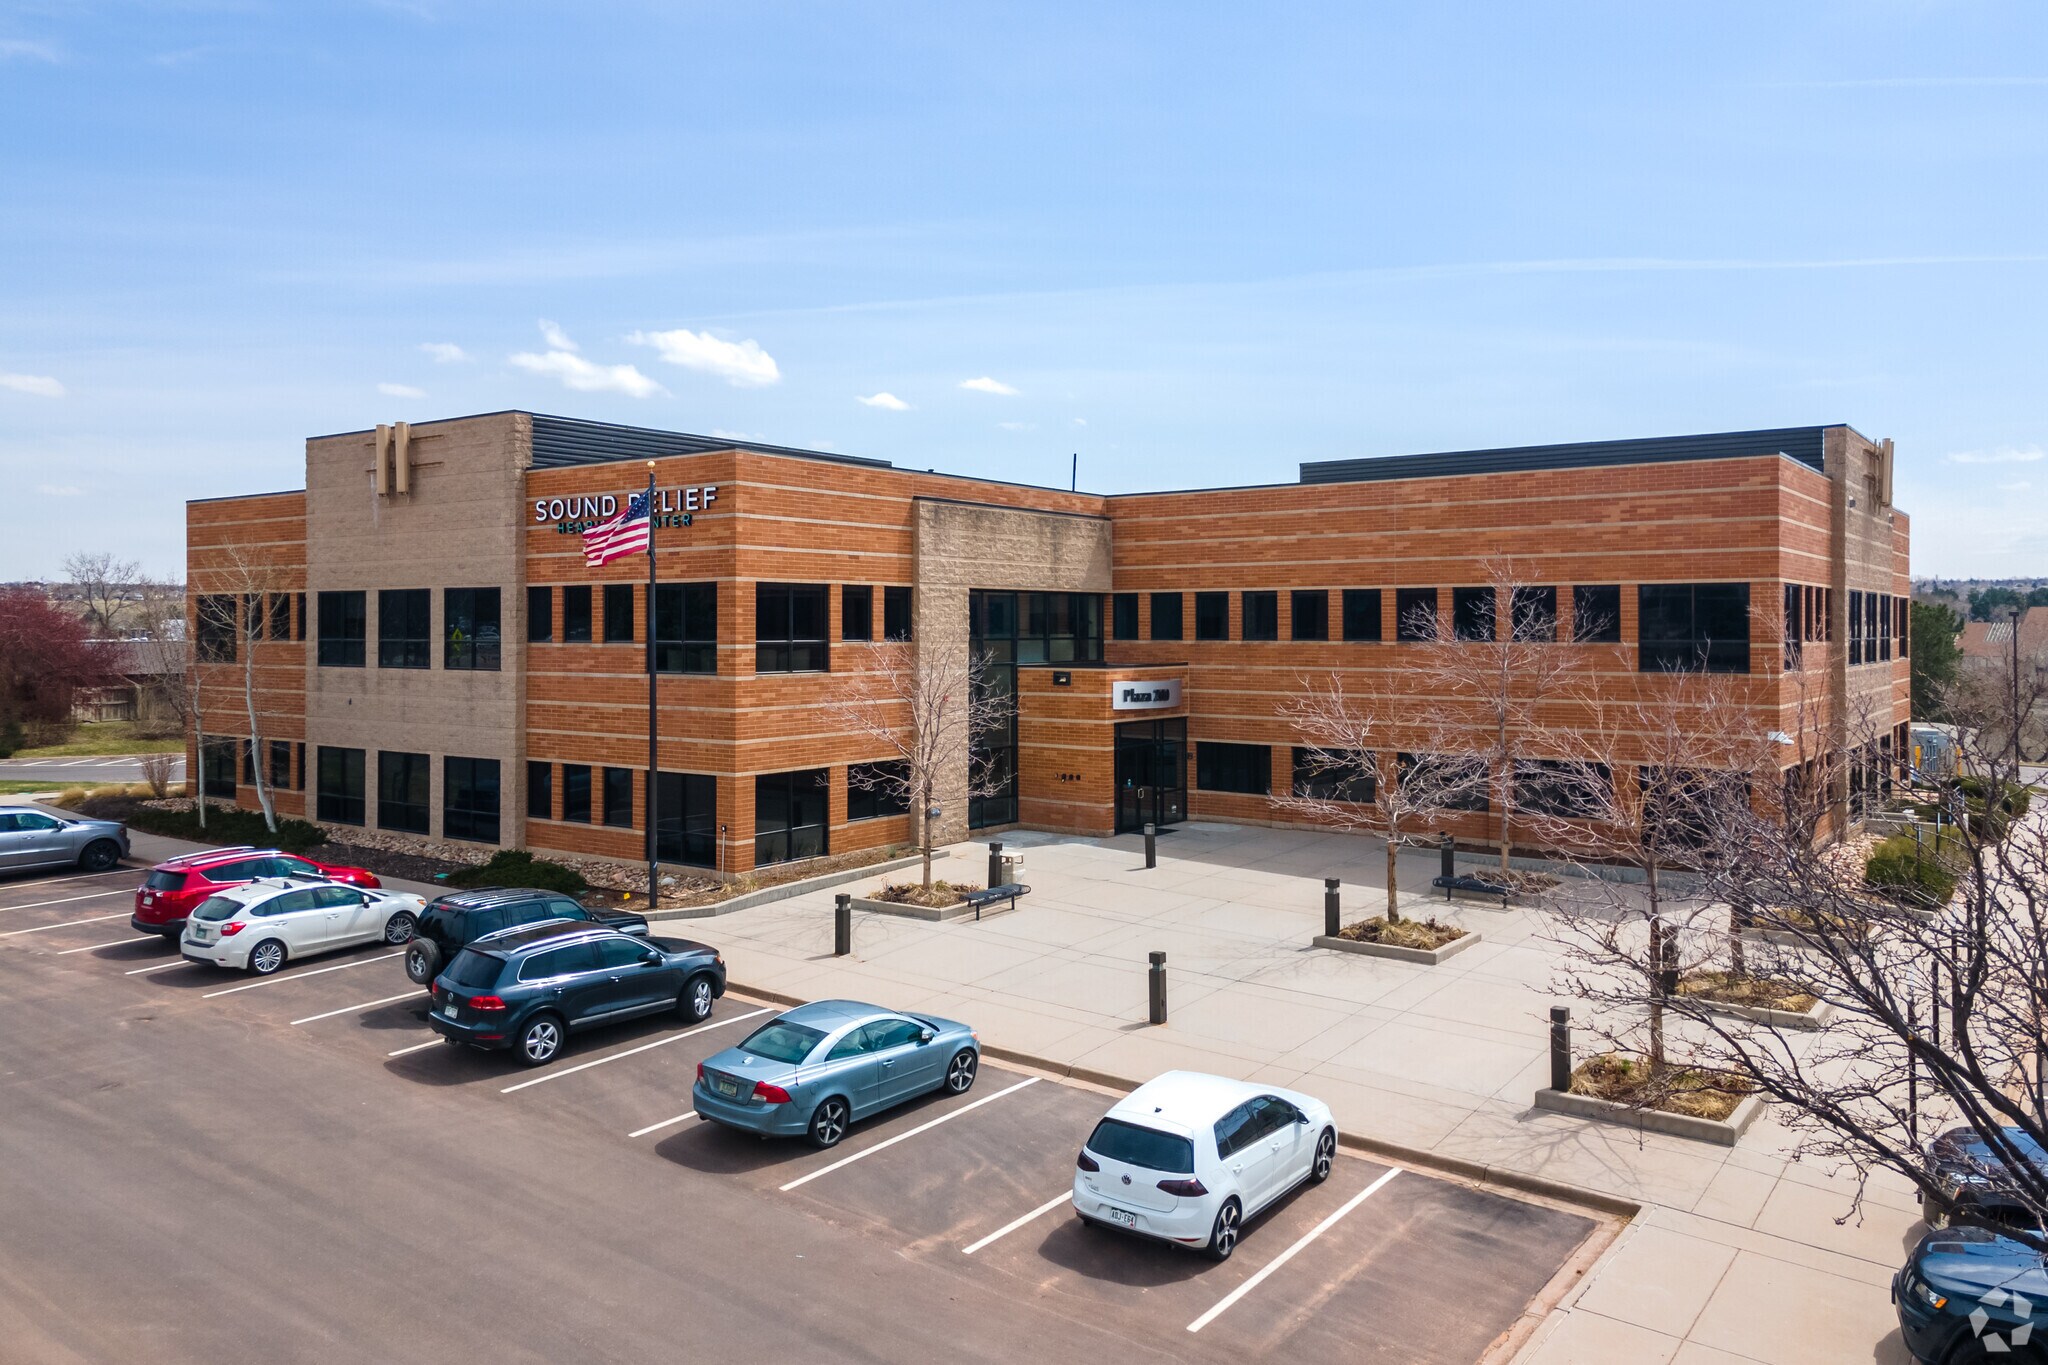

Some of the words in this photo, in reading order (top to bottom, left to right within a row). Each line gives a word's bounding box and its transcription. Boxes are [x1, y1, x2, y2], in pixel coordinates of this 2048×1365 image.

[535, 495, 617, 522] SOUND
[652, 513, 690, 528] NTER
[1123, 688, 1152, 703] Plaza
